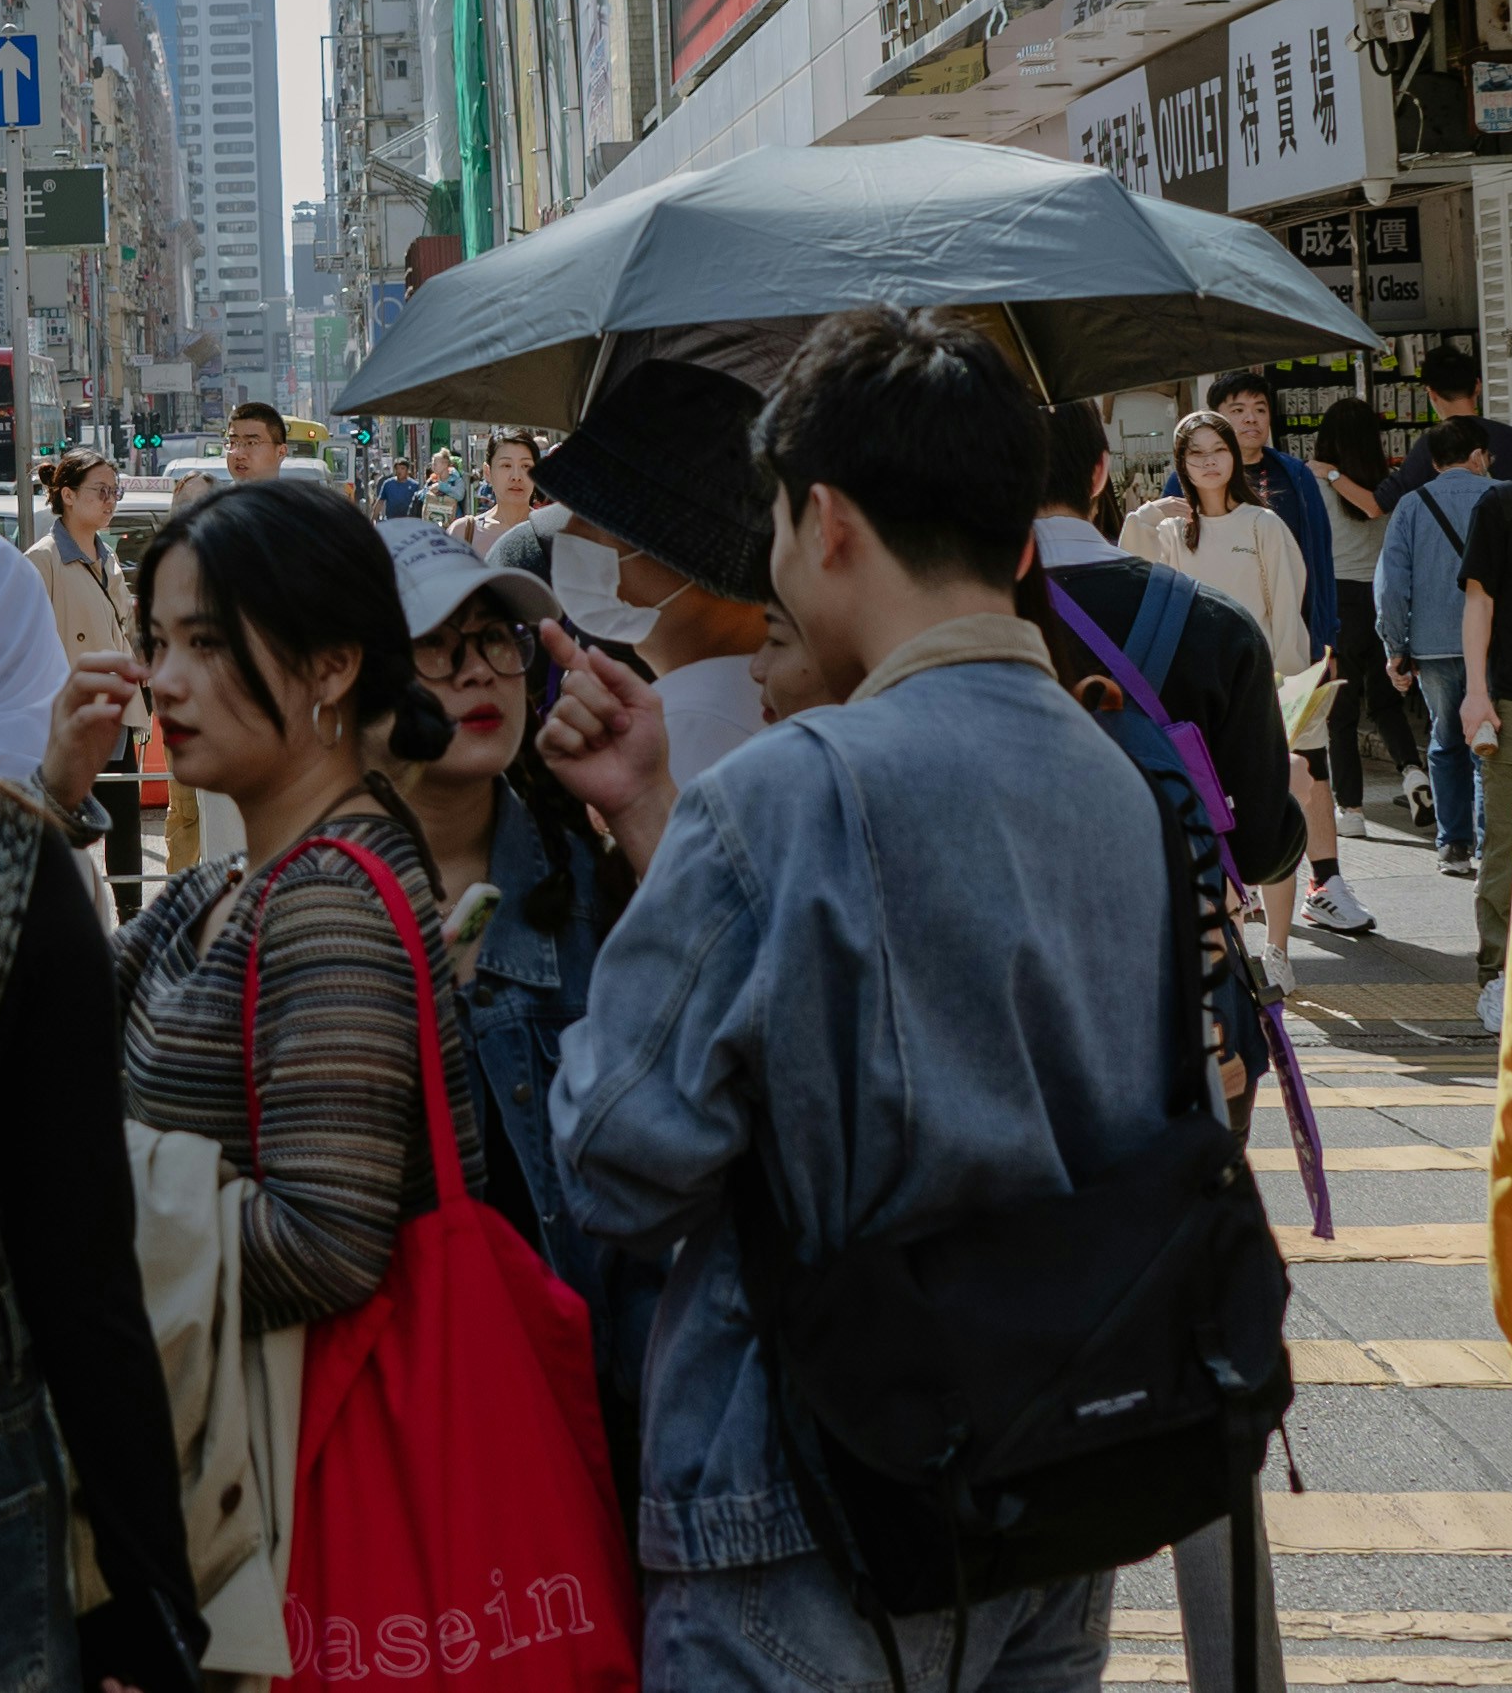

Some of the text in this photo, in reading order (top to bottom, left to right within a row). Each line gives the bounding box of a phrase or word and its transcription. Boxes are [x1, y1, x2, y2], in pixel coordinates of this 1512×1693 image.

[1158, 76, 1225, 185] OUTLET
[1237, 27, 1337, 167] 特賣場
[1378, 275, 1419, 302] Glass
[120, 479, 170, 490] TAXI
